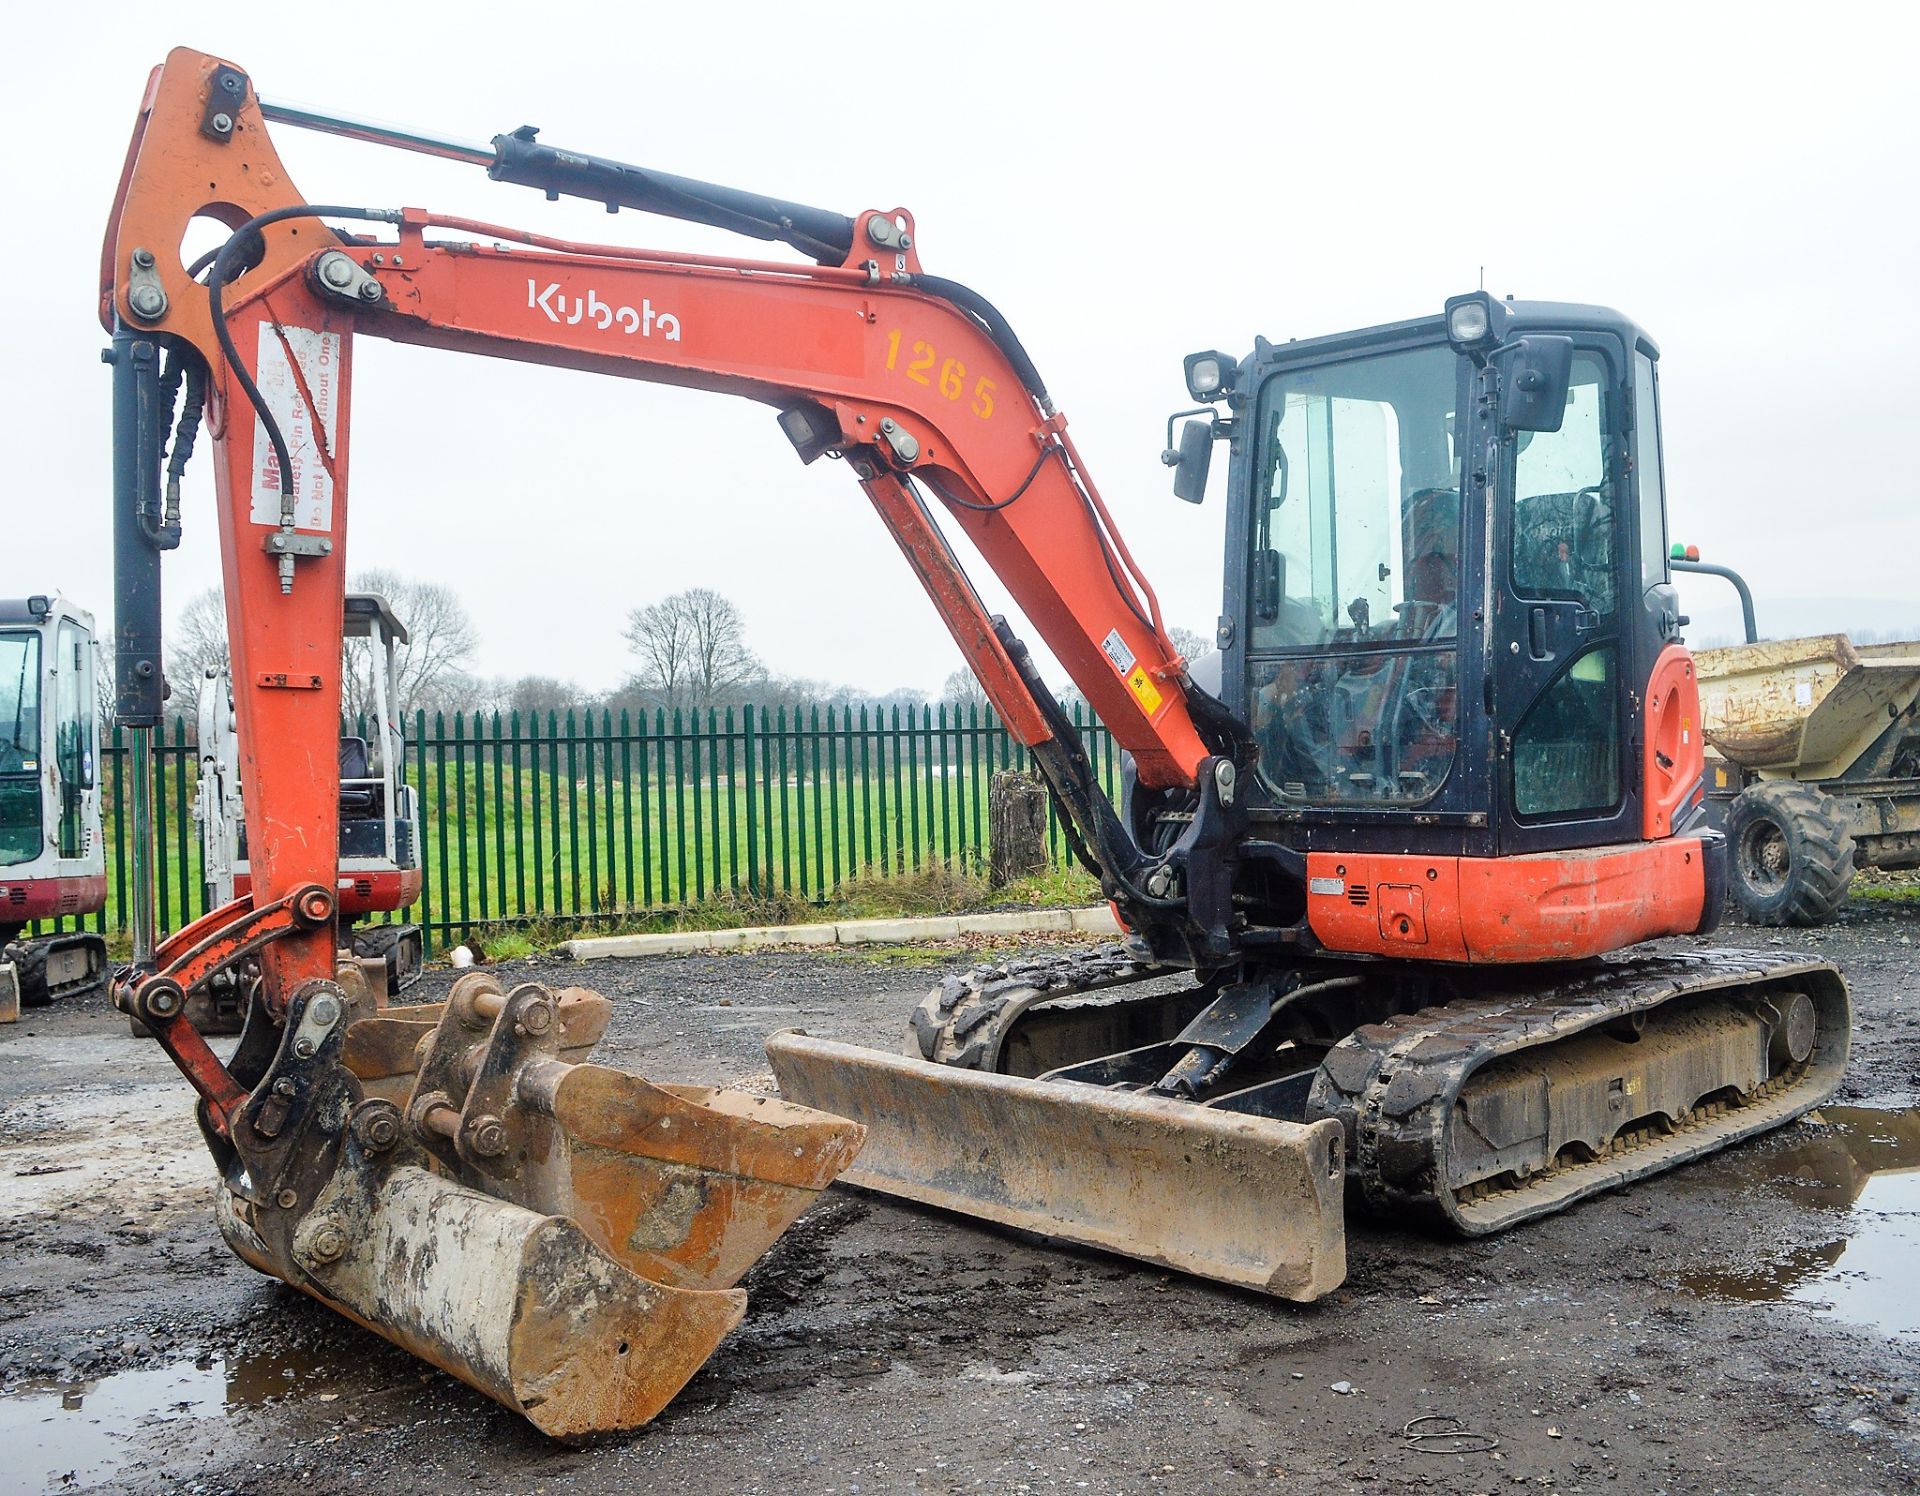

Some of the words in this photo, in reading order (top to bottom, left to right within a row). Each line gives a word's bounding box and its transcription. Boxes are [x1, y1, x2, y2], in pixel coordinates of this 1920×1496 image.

[528, 279, 680, 342] Kubota
[311, 474, 324, 501] Not
[318, 336, 331, 366] One
[886, 328, 998, 420] 1265
